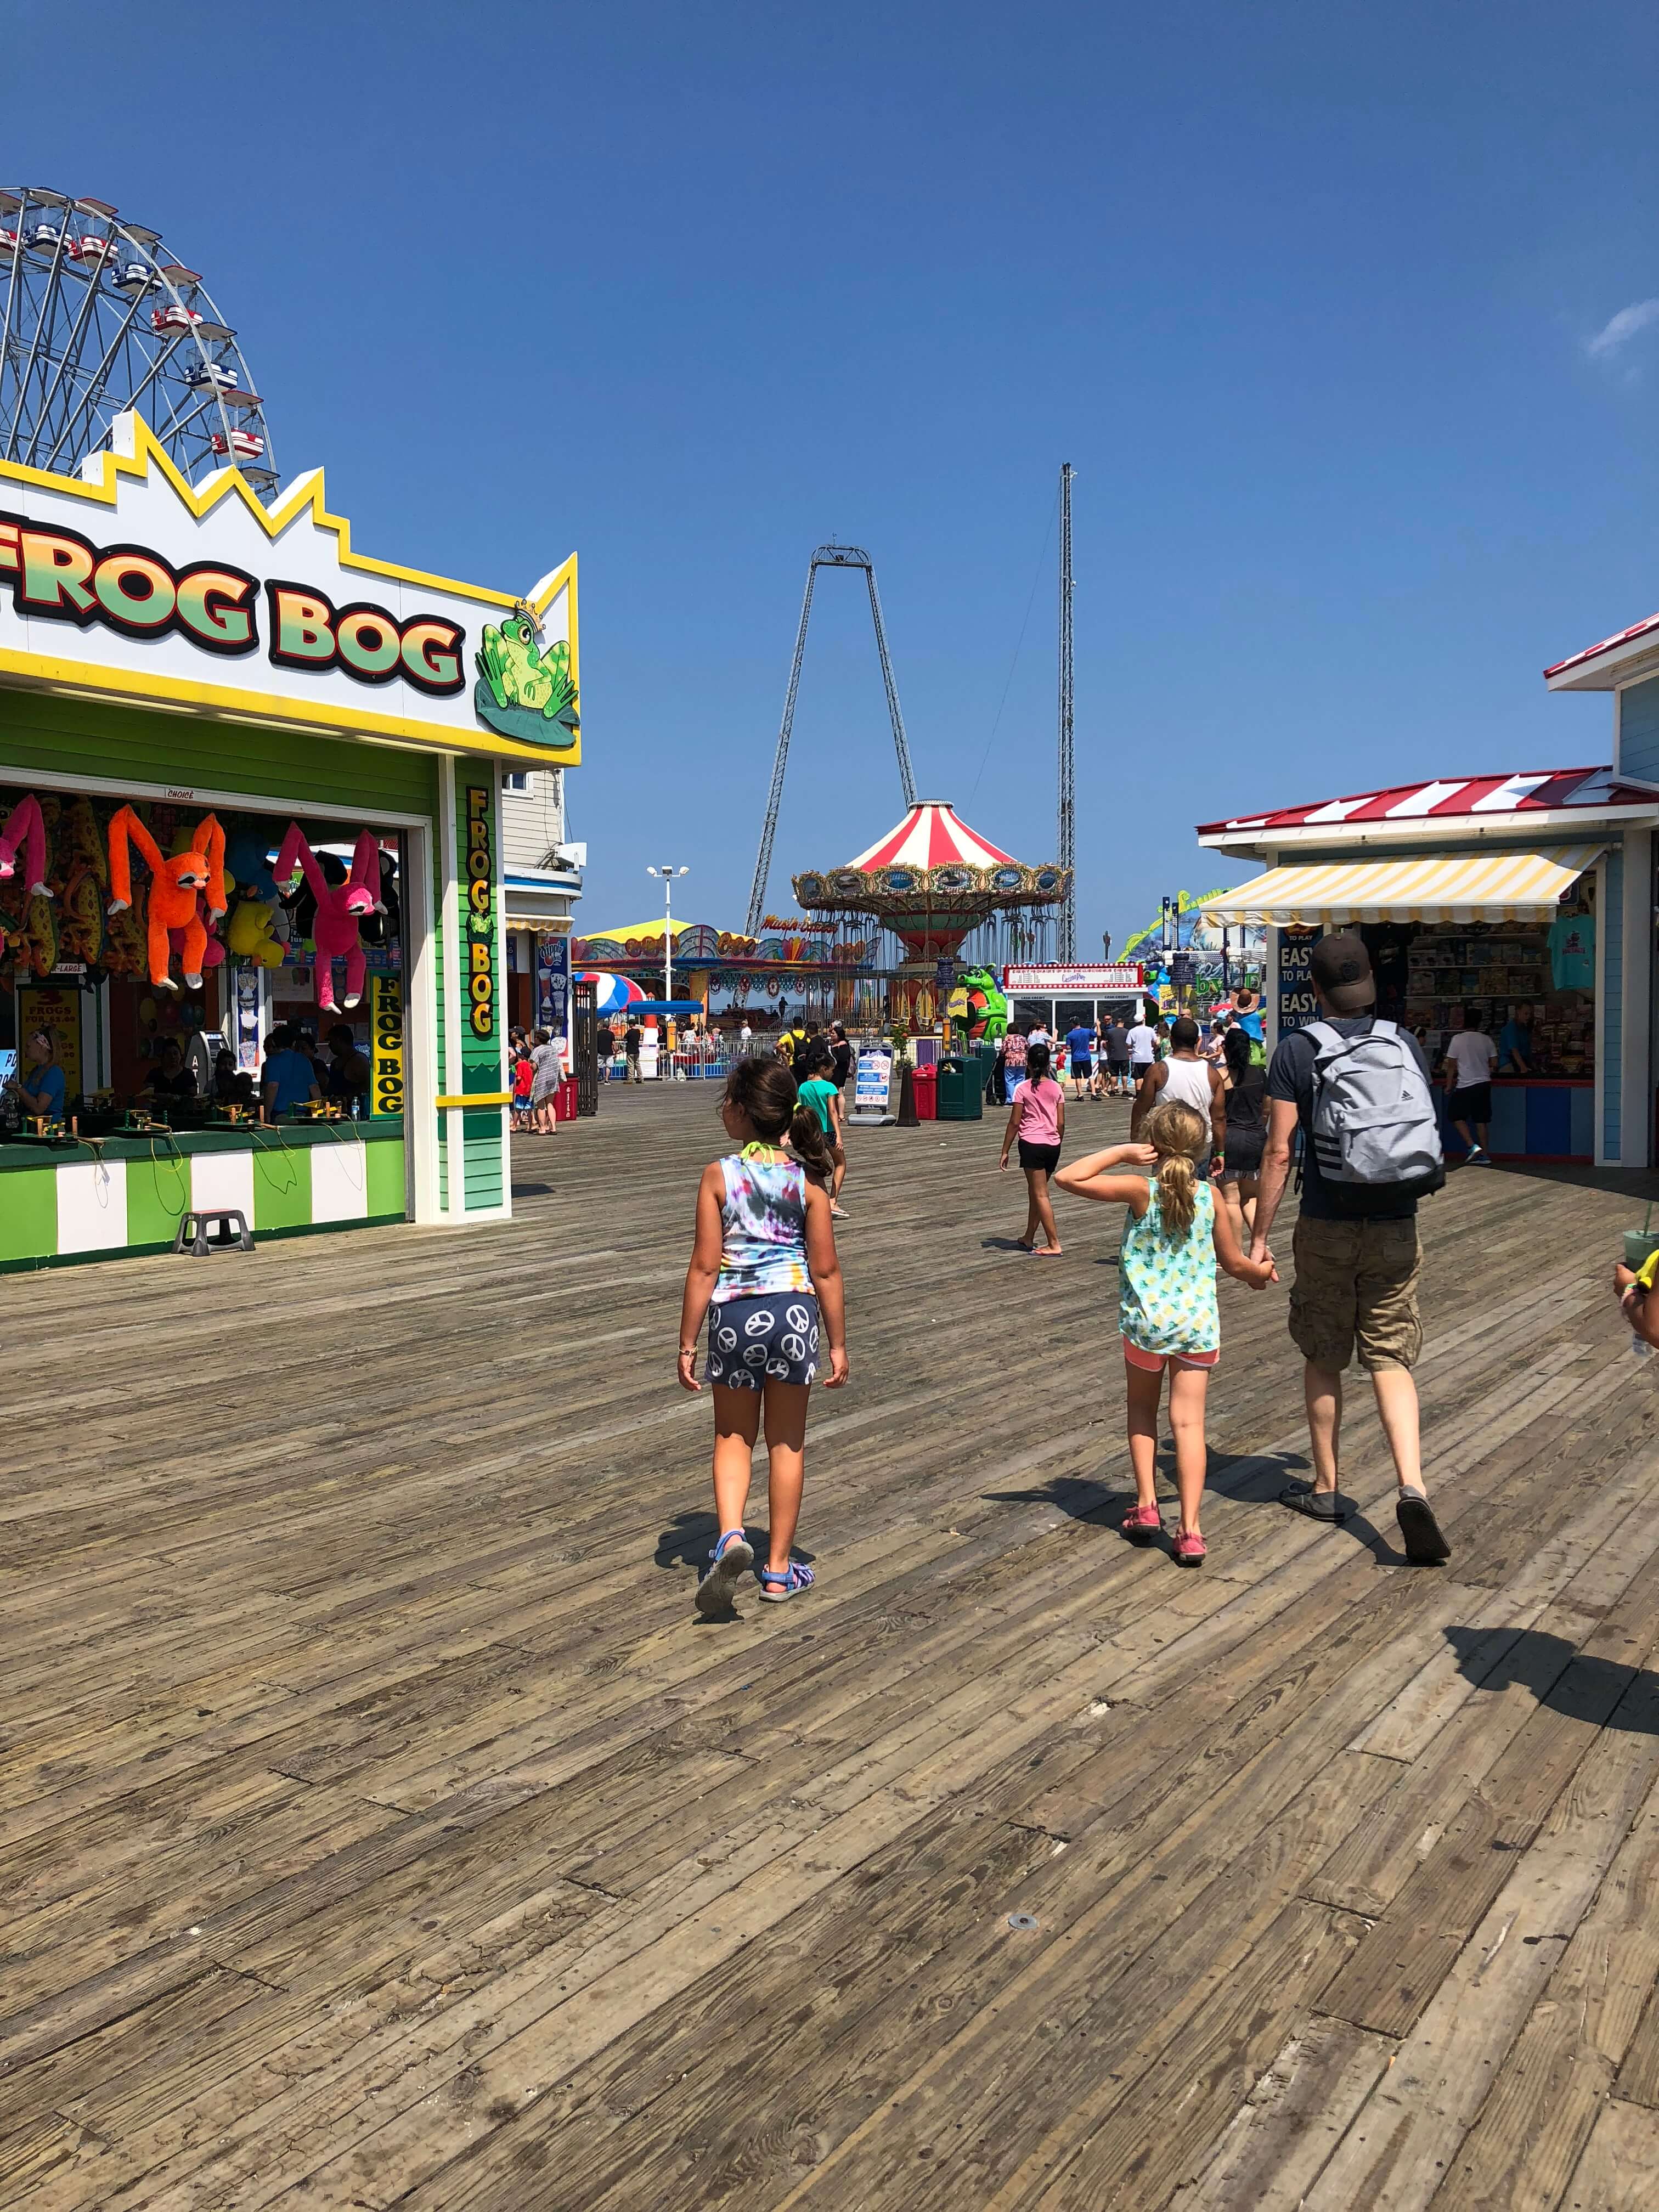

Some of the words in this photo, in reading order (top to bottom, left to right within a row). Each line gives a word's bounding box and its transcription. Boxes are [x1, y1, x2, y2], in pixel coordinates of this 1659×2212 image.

[275, 587, 462, 686] BOG
[167, 790, 194, 799] CHOICE
[469, 789, 489, 910] FROG
[472, 943, 492, 1034] BOG
[1282, 970, 1294, 981] TO
[1296, 970, 1312, 981] PLA
[29, 1006, 71, 1014] FROGS
[377, 976, 403, 1050] FROG
[1281, 993, 1317, 1013] EASY
[1282, 1017, 1295, 1027] TO
[378, 1058, 403, 1113] BOG
